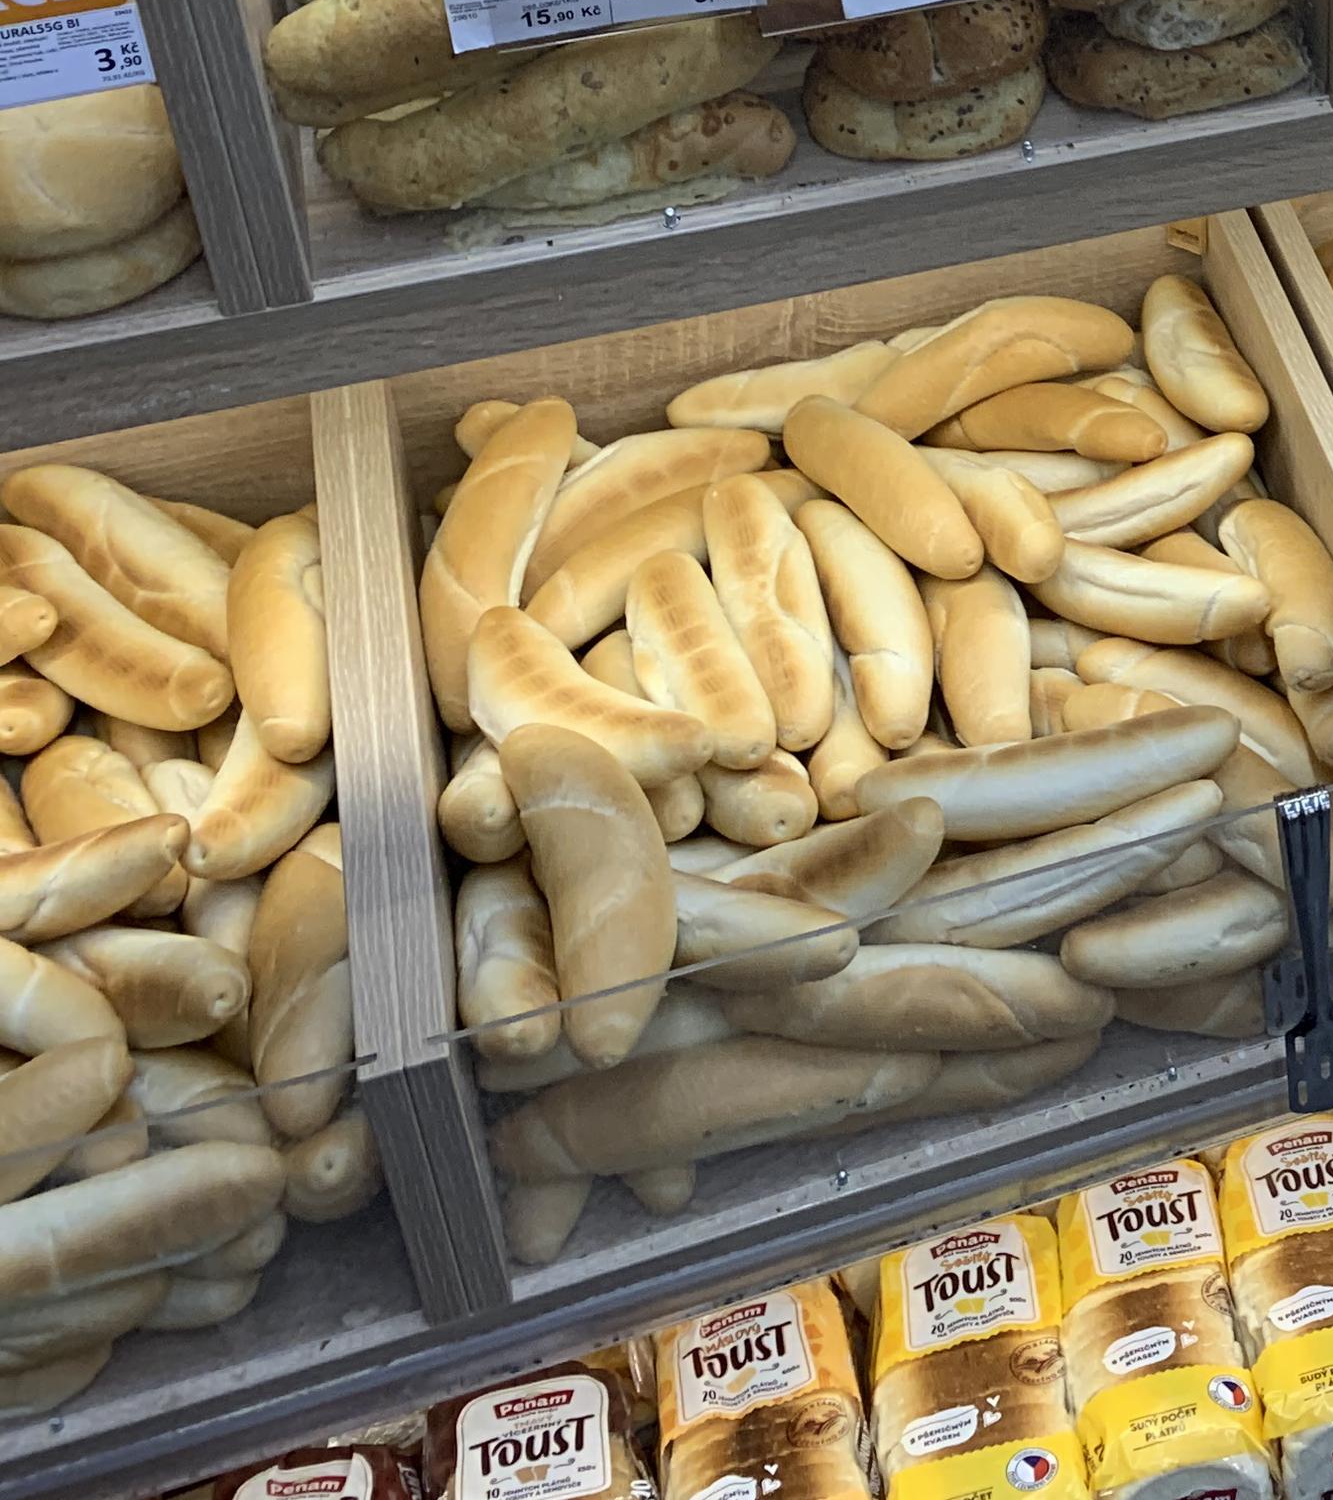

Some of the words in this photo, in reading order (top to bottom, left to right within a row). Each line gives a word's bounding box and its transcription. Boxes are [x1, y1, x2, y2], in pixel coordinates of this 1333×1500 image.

[582, 5, 601, 18] Kč
[121, 42, 139, 55] Kč
[1271, 1133, 1329, 1154] Penam
[1116, 1173, 1174, 1192] Penam
[1096, 1189, 1202, 1242] TOUST
[1279, 1208, 1292, 1221] 20
[935, 1233, 997, 1257] Penam
[1119, 1250, 1132, 1264] 20
[913, 1252, 1022, 1312] TOUST
[701, 1307, 762, 1335] Penam
[1292, 1306, 1325, 1325] KVASEM
[931, 1321, 944, 1335] 20
[682, 1320, 792, 1379] TOUST
[1125, 1348, 1160, 1367] KVASEM
[500, 1393, 567, 1417] Penam
[702, 1389, 716, 1402] 20
[1161, 1407, 1197, 1425] POČET
[918, 1417, 972, 1439] PŠENIČNÝM
[469, 1414, 595, 1476] TOUST
[924, 1429, 962, 1447] KVASEM
[269, 1479, 340, 1495] Penam
[486, 1488, 500, 1499] 10
